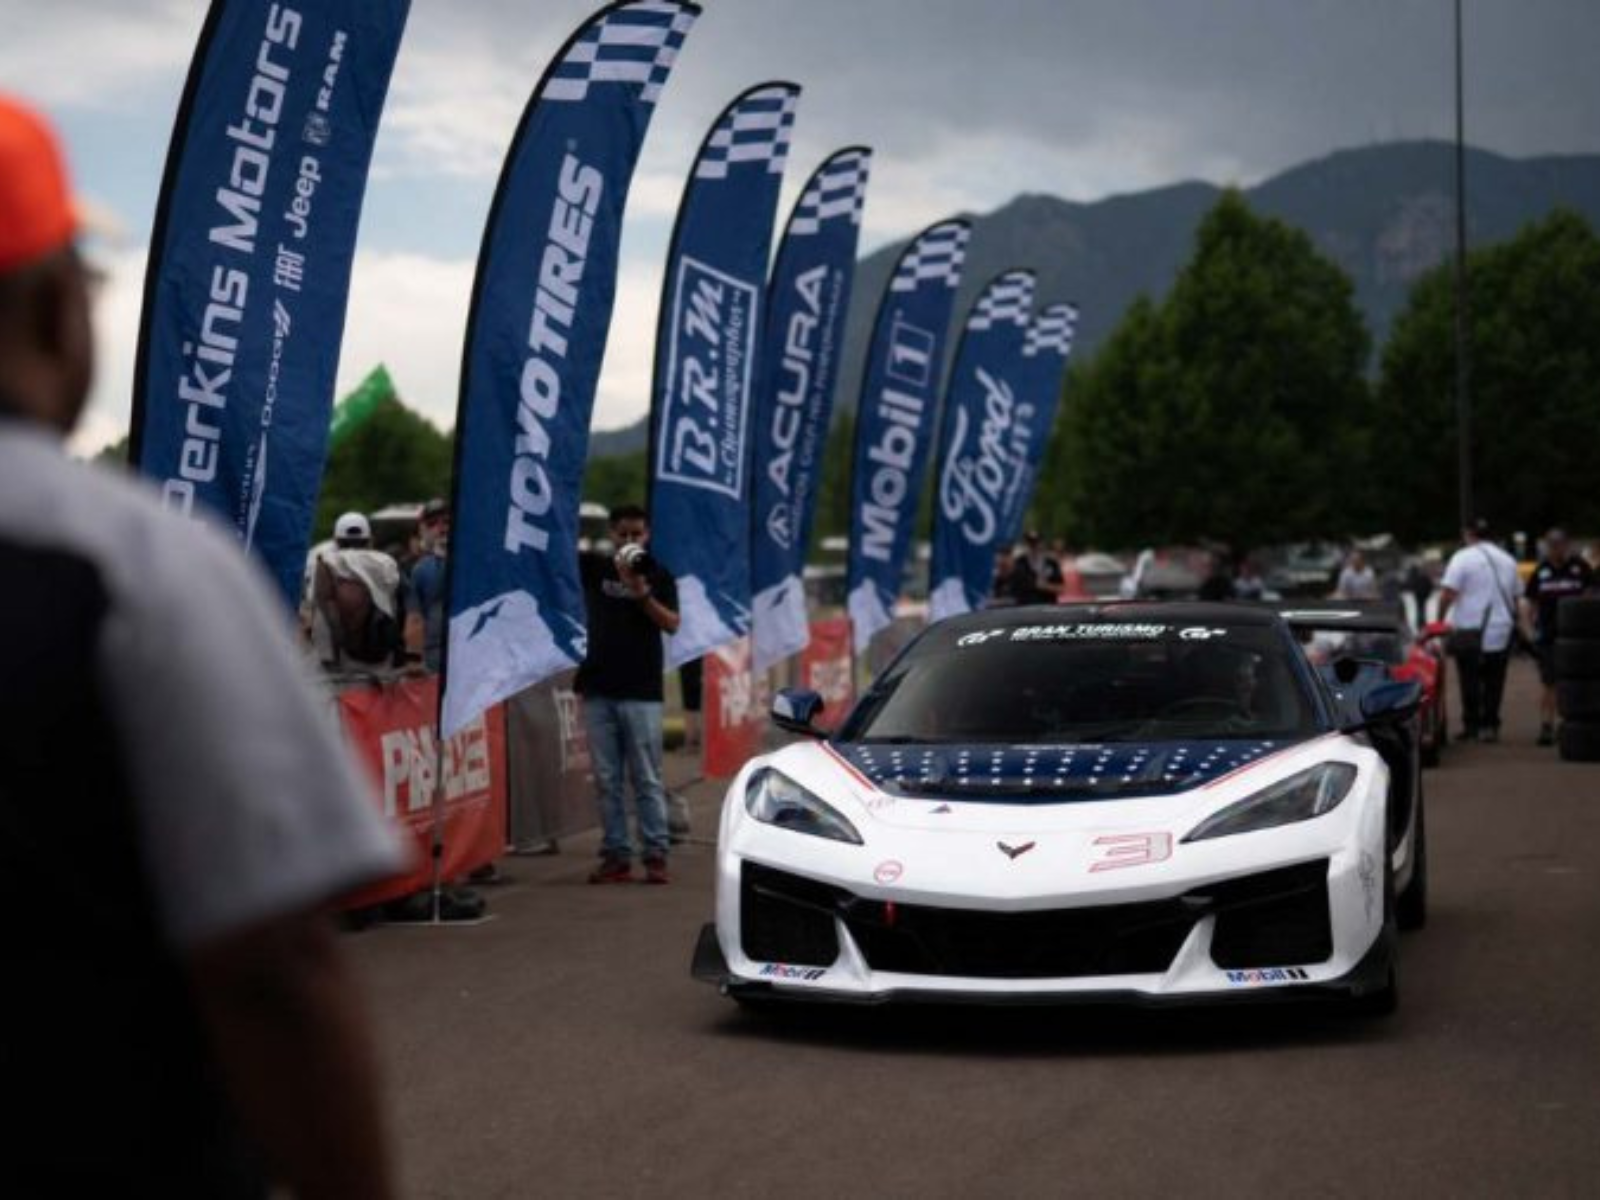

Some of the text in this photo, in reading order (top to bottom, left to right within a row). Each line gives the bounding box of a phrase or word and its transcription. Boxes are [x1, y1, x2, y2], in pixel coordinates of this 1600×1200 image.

[209, 3, 303, 254] Motors
[315, 30, 348, 111] RAM
[284, 155, 322, 238] Jeep
[504, 153, 604, 555] TOYO TIRES
[768, 264, 828, 495] ACURA
[861, 388, 924, 562] Mobil
[939, 366, 1014, 546] Ford
[1087, 831, 1173, 873] 3
[1226, 967, 1287, 982] Mobil
